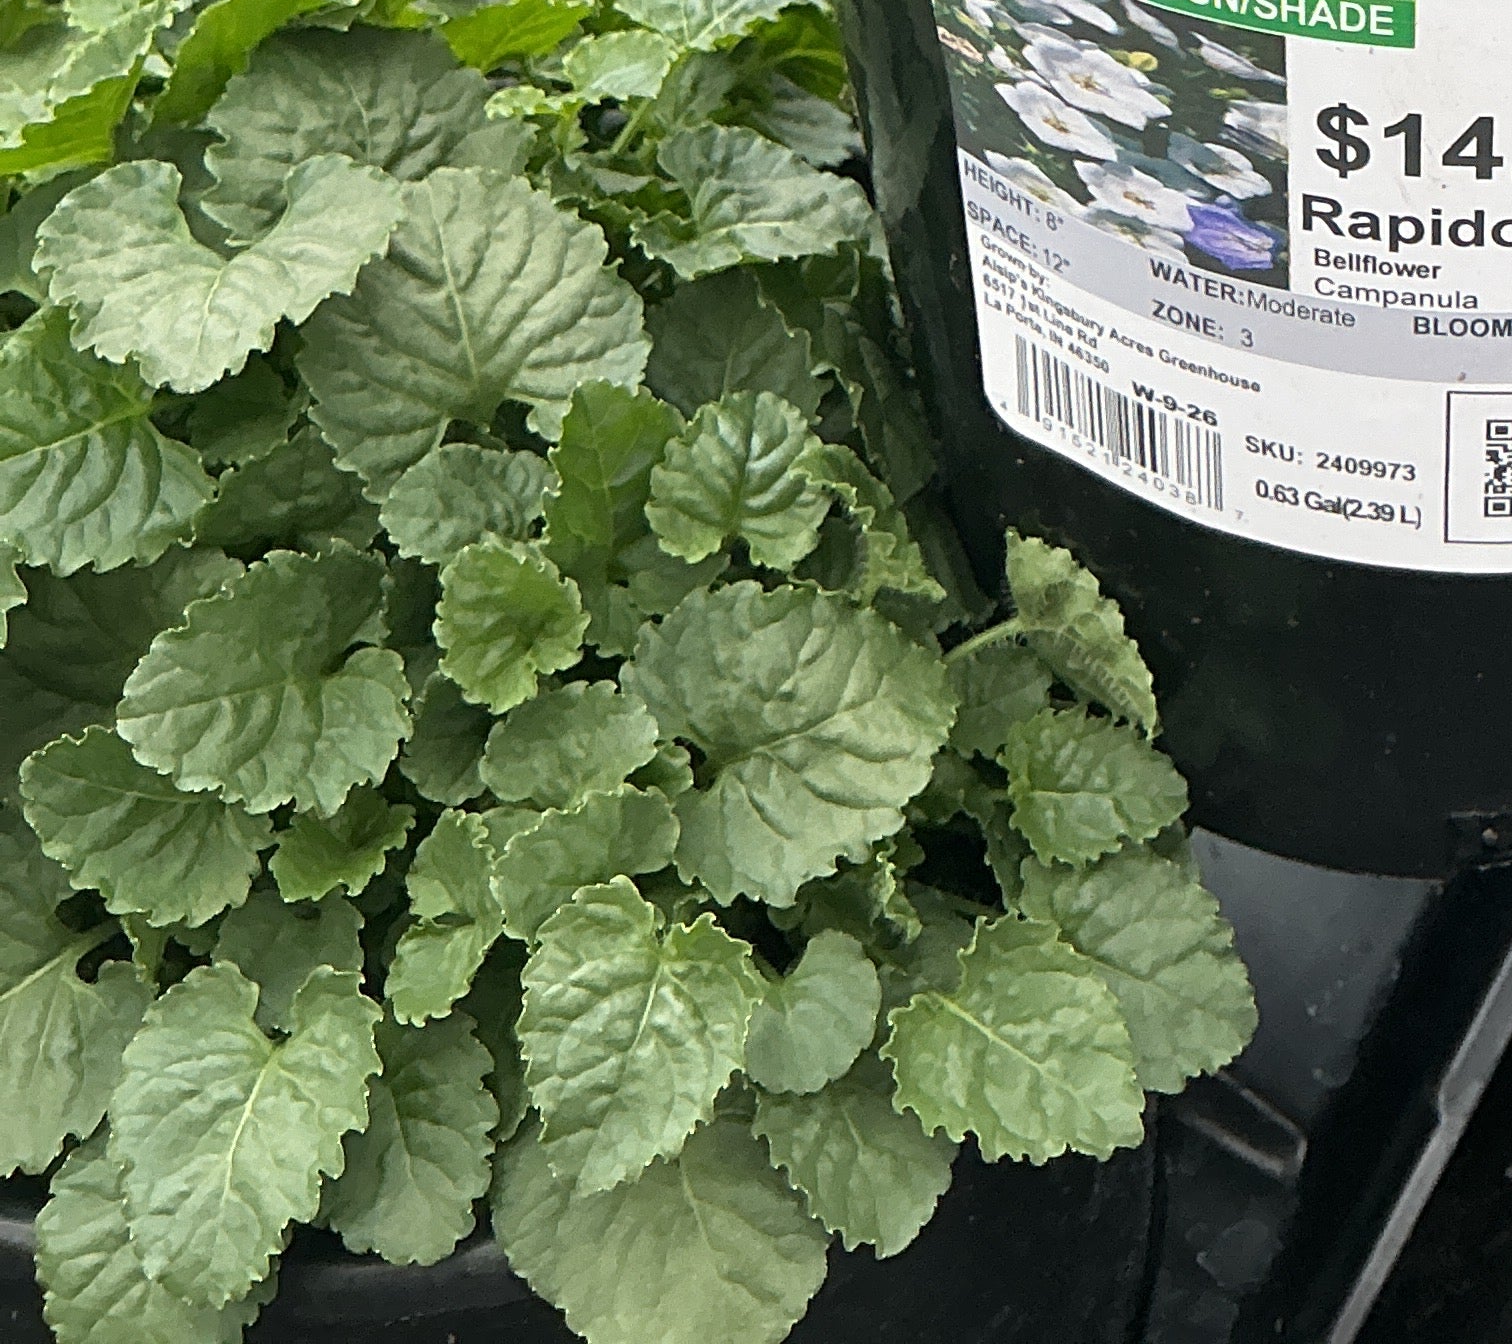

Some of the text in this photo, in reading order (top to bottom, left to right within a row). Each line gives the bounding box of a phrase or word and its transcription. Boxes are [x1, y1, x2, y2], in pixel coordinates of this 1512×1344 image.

[964, 158, 1041, 223] HEIGHT:
[967, 200, 1070, 273] SPACE: 12"
[981, 235, 1050, 287] Grown by:
[1314, 249, 1441, 279] Bellflower
[983, 274, 1014, 299] 6517
[1077, 330, 1097, 349] Rd
[1314, 277, 1478, 309] Campanula
[984, 293, 1001, 311] La
[1068, 342, 1110, 374] 46350
[1032, 286, 1104, 337] Kingsbury
[1110, 329, 1153, 357] Acres
[1159, 350, 1261, 393] Greenhouse
[1152, 299, 1254, 347] ZONE: 3
[1132, 380, 1219, 426] W-9-26
[1245, 435, 1416, 481] SKU: 2409973
[1255, 479, 1299, 506] 0.63
[1400, 504, 1422, 530] L)
